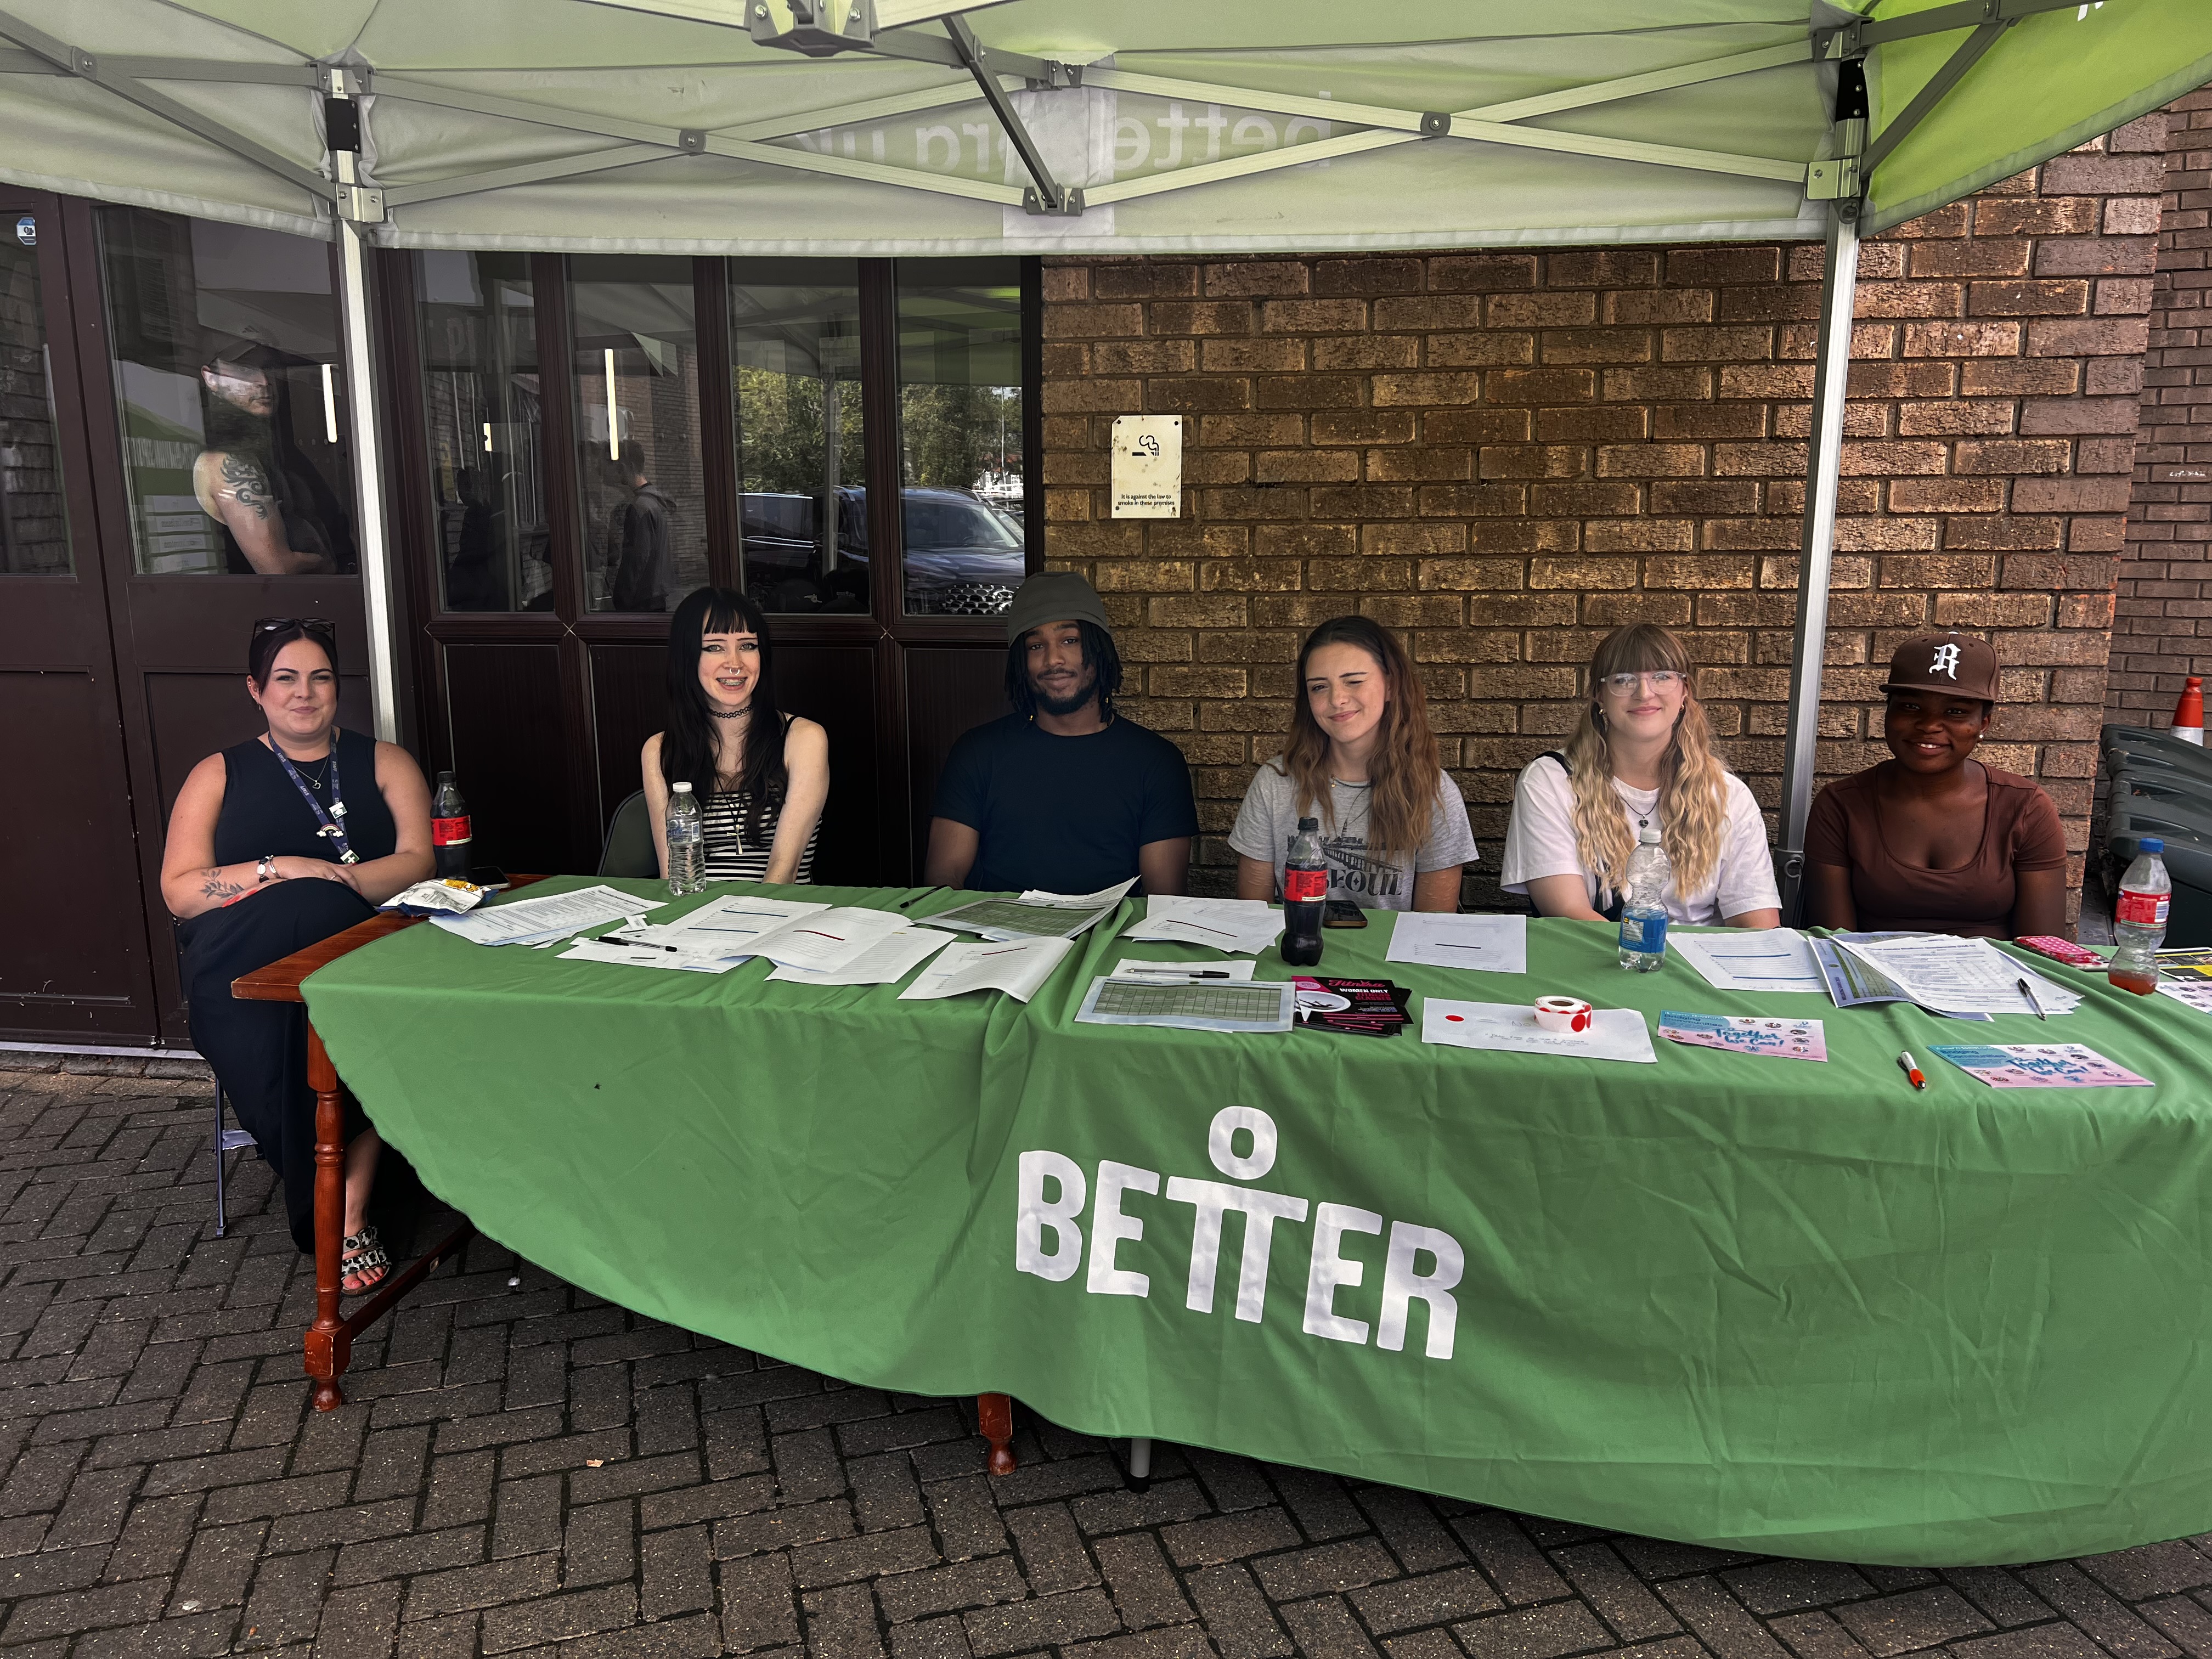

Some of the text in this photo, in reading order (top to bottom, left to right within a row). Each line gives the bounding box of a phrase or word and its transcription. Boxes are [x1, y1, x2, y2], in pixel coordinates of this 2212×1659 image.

[276, 752, 286, 763] STAFF
[299, 785, 310, 797] STAFF
[1327, 868, 1402, 896] EOUL
[1715, 1028, 1782, 1041] Together
[2005, 1057, 2076, 1071] Together
[1015, 1149, 1465, 1360] BETTER
